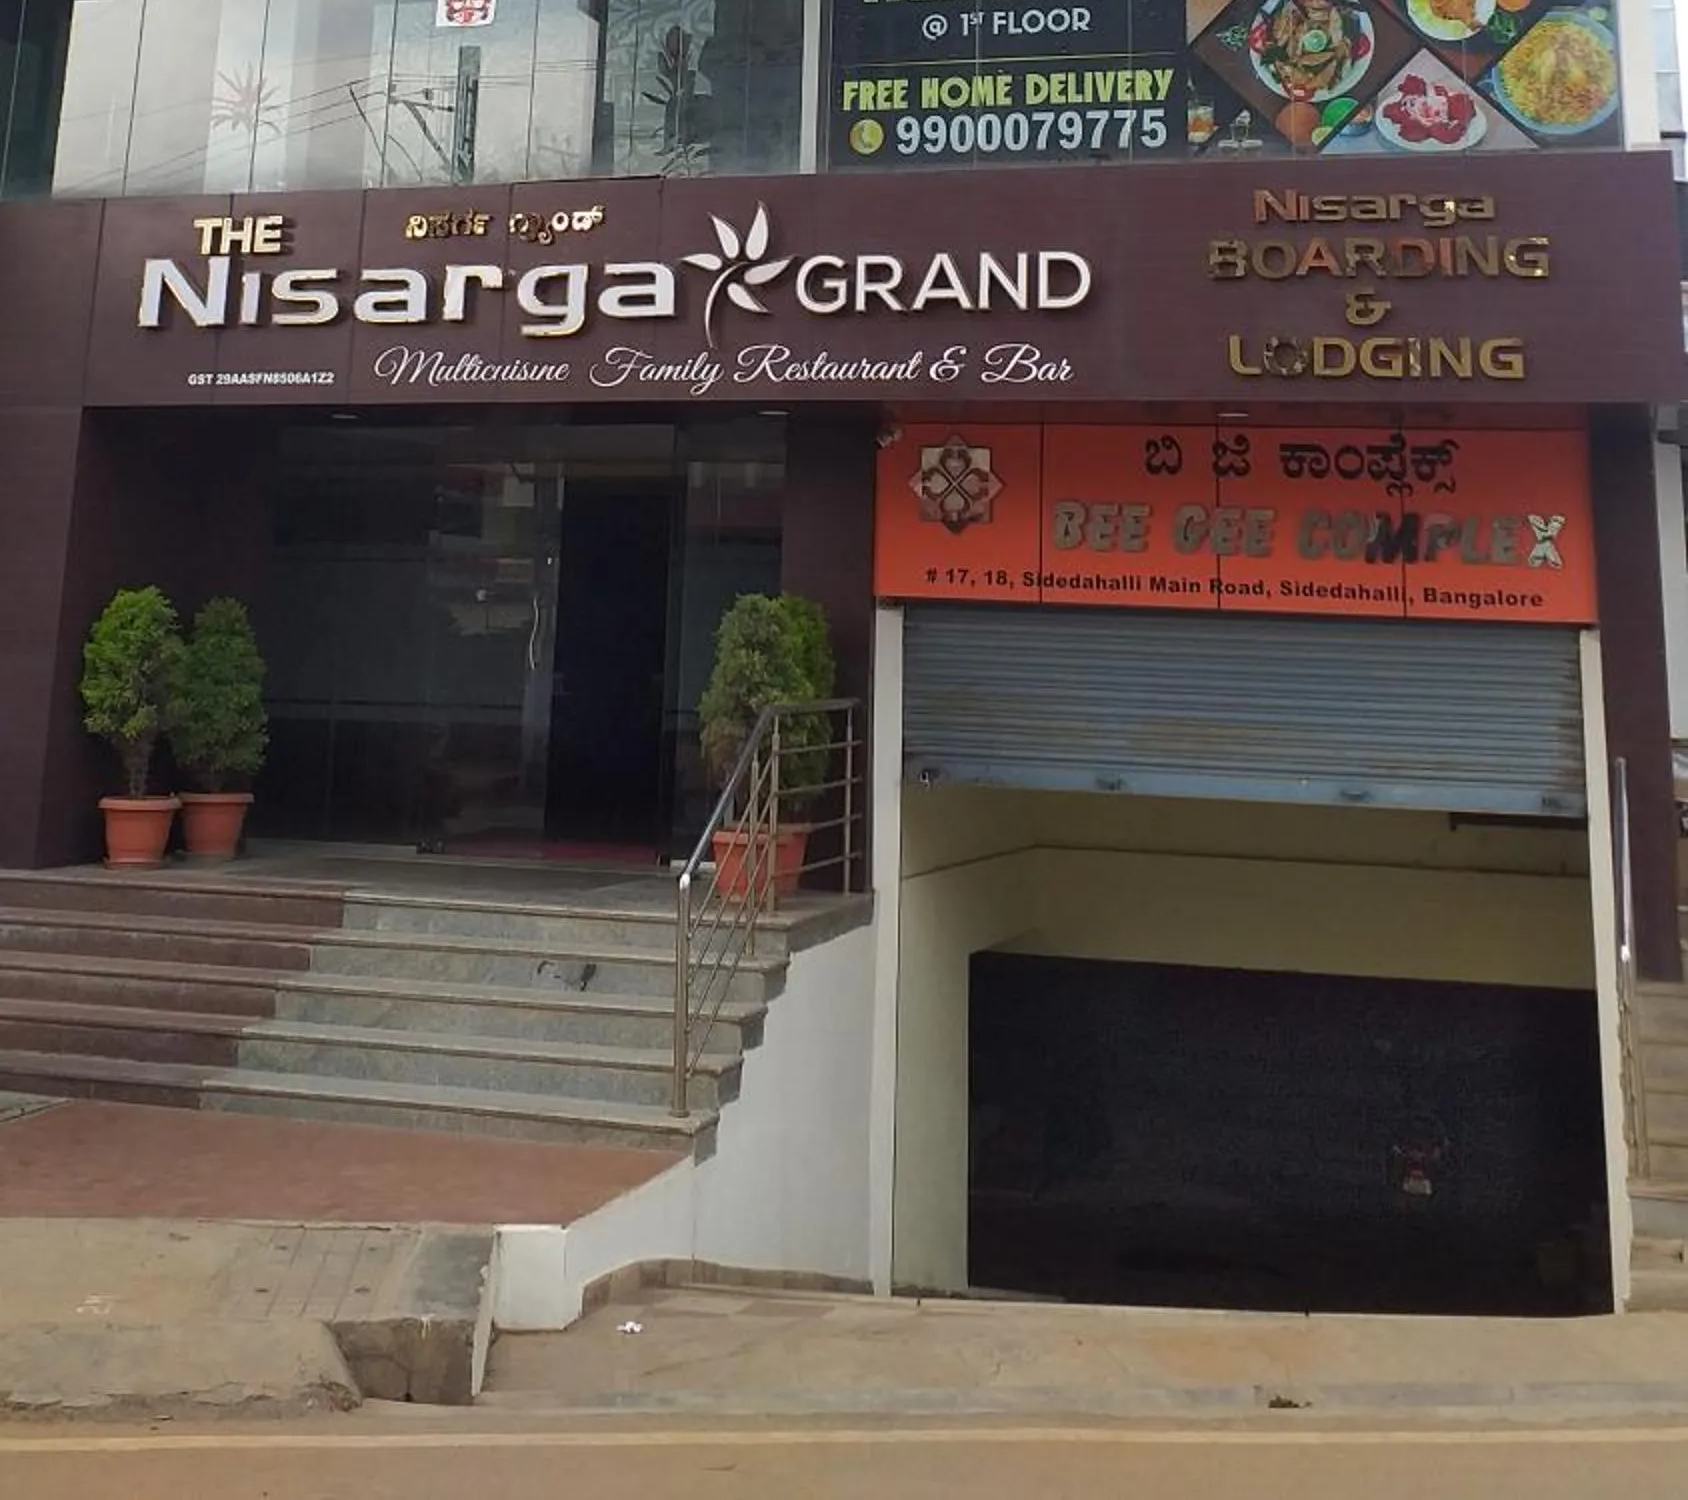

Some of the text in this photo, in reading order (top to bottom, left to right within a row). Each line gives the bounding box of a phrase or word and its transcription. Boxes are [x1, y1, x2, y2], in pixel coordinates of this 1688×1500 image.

[922, 13, 948, 41] @
[992, 7, 1091, 36] FLOOR
[843, 68, 1175, 111] FREE HOME DELIVERY
[896, 108, 1167, 155] 9900079775
[1253, 189, 1495, 228] Nisarga
[193, 214, 283, 255] THE
[1206, 236, 1550, 280] BOARDING
[138, 251, 1092, 337] Nisarga GRAND
[1345, 285, 1392, 325] &
[589, 347, 722, 396] Family
[733, 344, 923, 383] Restaurant
[929, 346, 966, 383] &
[980, 343, 1075, 383] Bar
[1228, 334, 1525, 379] LODGING
[188, 373, 212, 385] GST
[1145, 434, 1182, 475] ಬಿ
[1212, 434, 1250, 478] ಜಿ
[1052, 500, 1566, 570] BEE GEE COMPLEX
[926, 567, 938, 583] #
[945, 569, 976, 586] 17,
[984, 570, 1015, 589] 18,
[1022, 571, 1141, 591] Sidedahalli
[1150, 577, 1201, 593] Main
[1210, 577, 1271, 598] Road,
[1423, 587, 1544, 609] Bangalore
